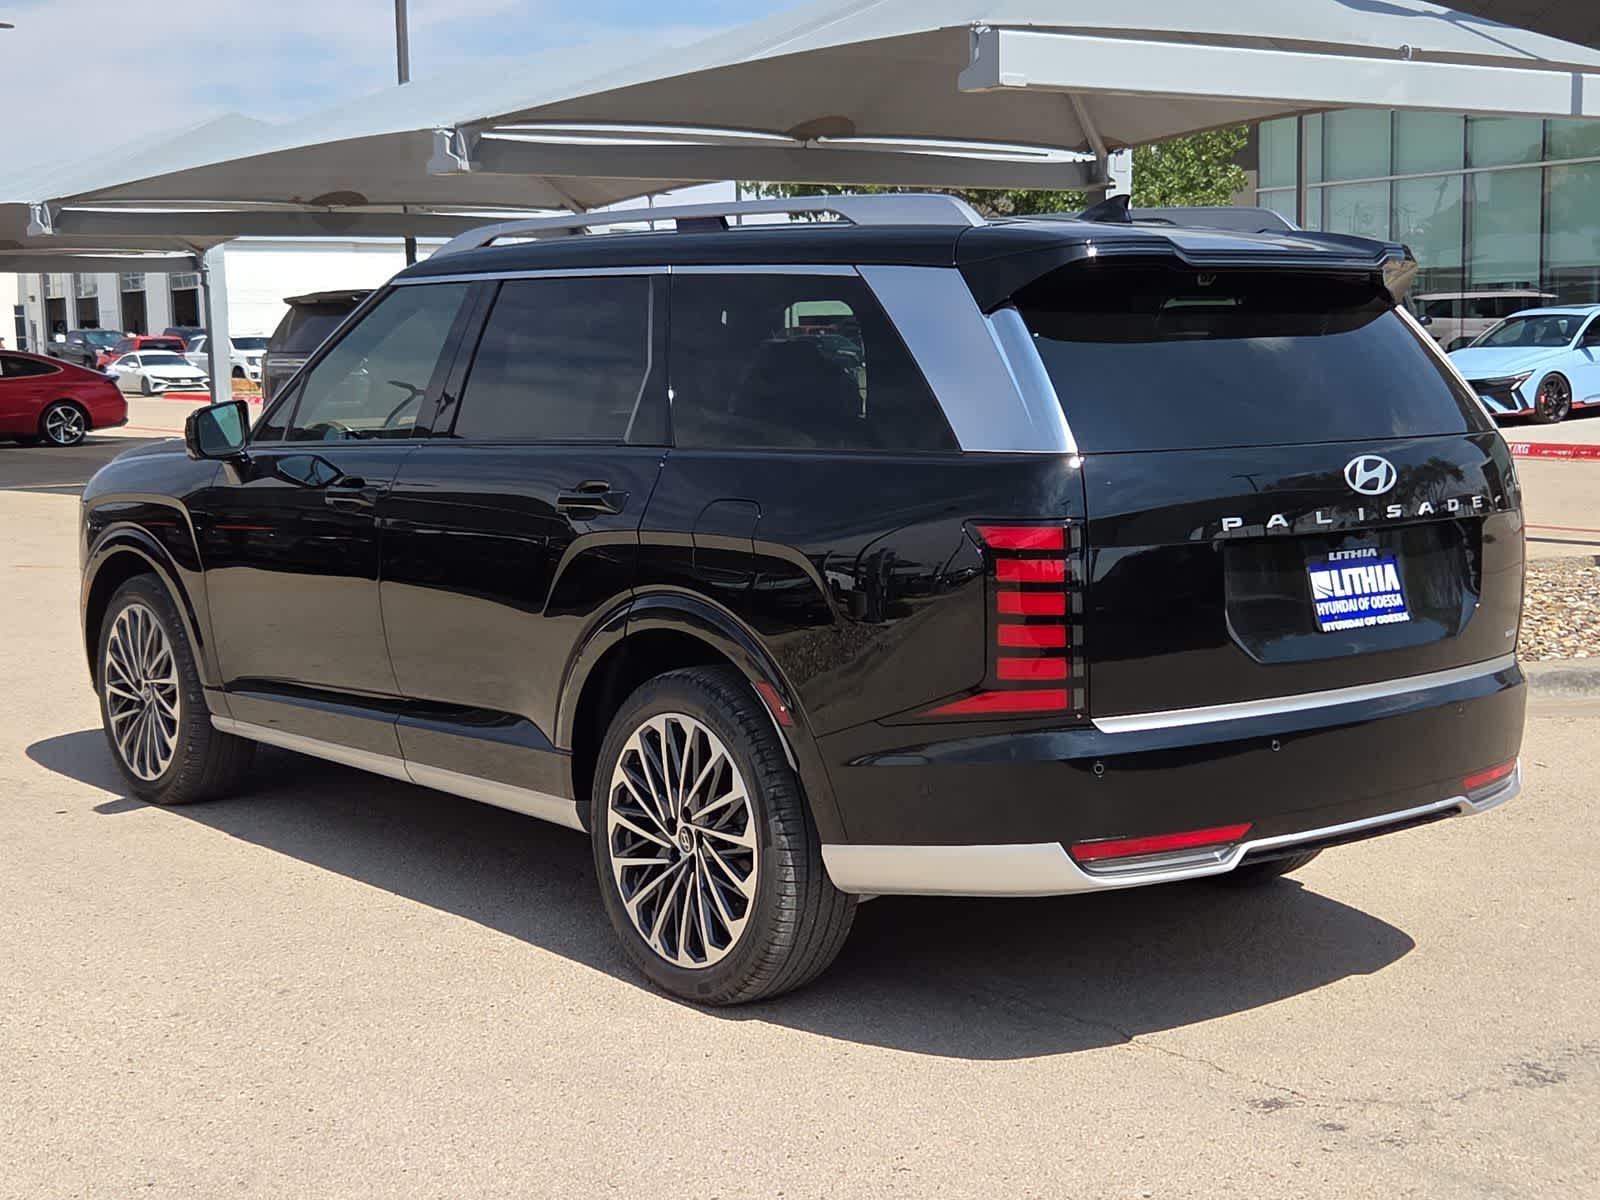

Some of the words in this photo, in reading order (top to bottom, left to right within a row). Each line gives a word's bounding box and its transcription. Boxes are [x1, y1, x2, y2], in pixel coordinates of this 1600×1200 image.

[1221, 495, 1483, 532] PALISADE
[1328, 549, 1377, 560] LITHIA
[1330, 564, 1400, 597] LITHIA
[1316, 598, 1358, 616] HYUNDAI
[1358, 597, 1370, 610] OF
[1370, 594, 1403, 608] ODESSA
[1322, 618, 1364, 632] HYUNDAI
[1364, 617, 1376, 625] OF
[1377, 612, 1409, 624] ODESSA
